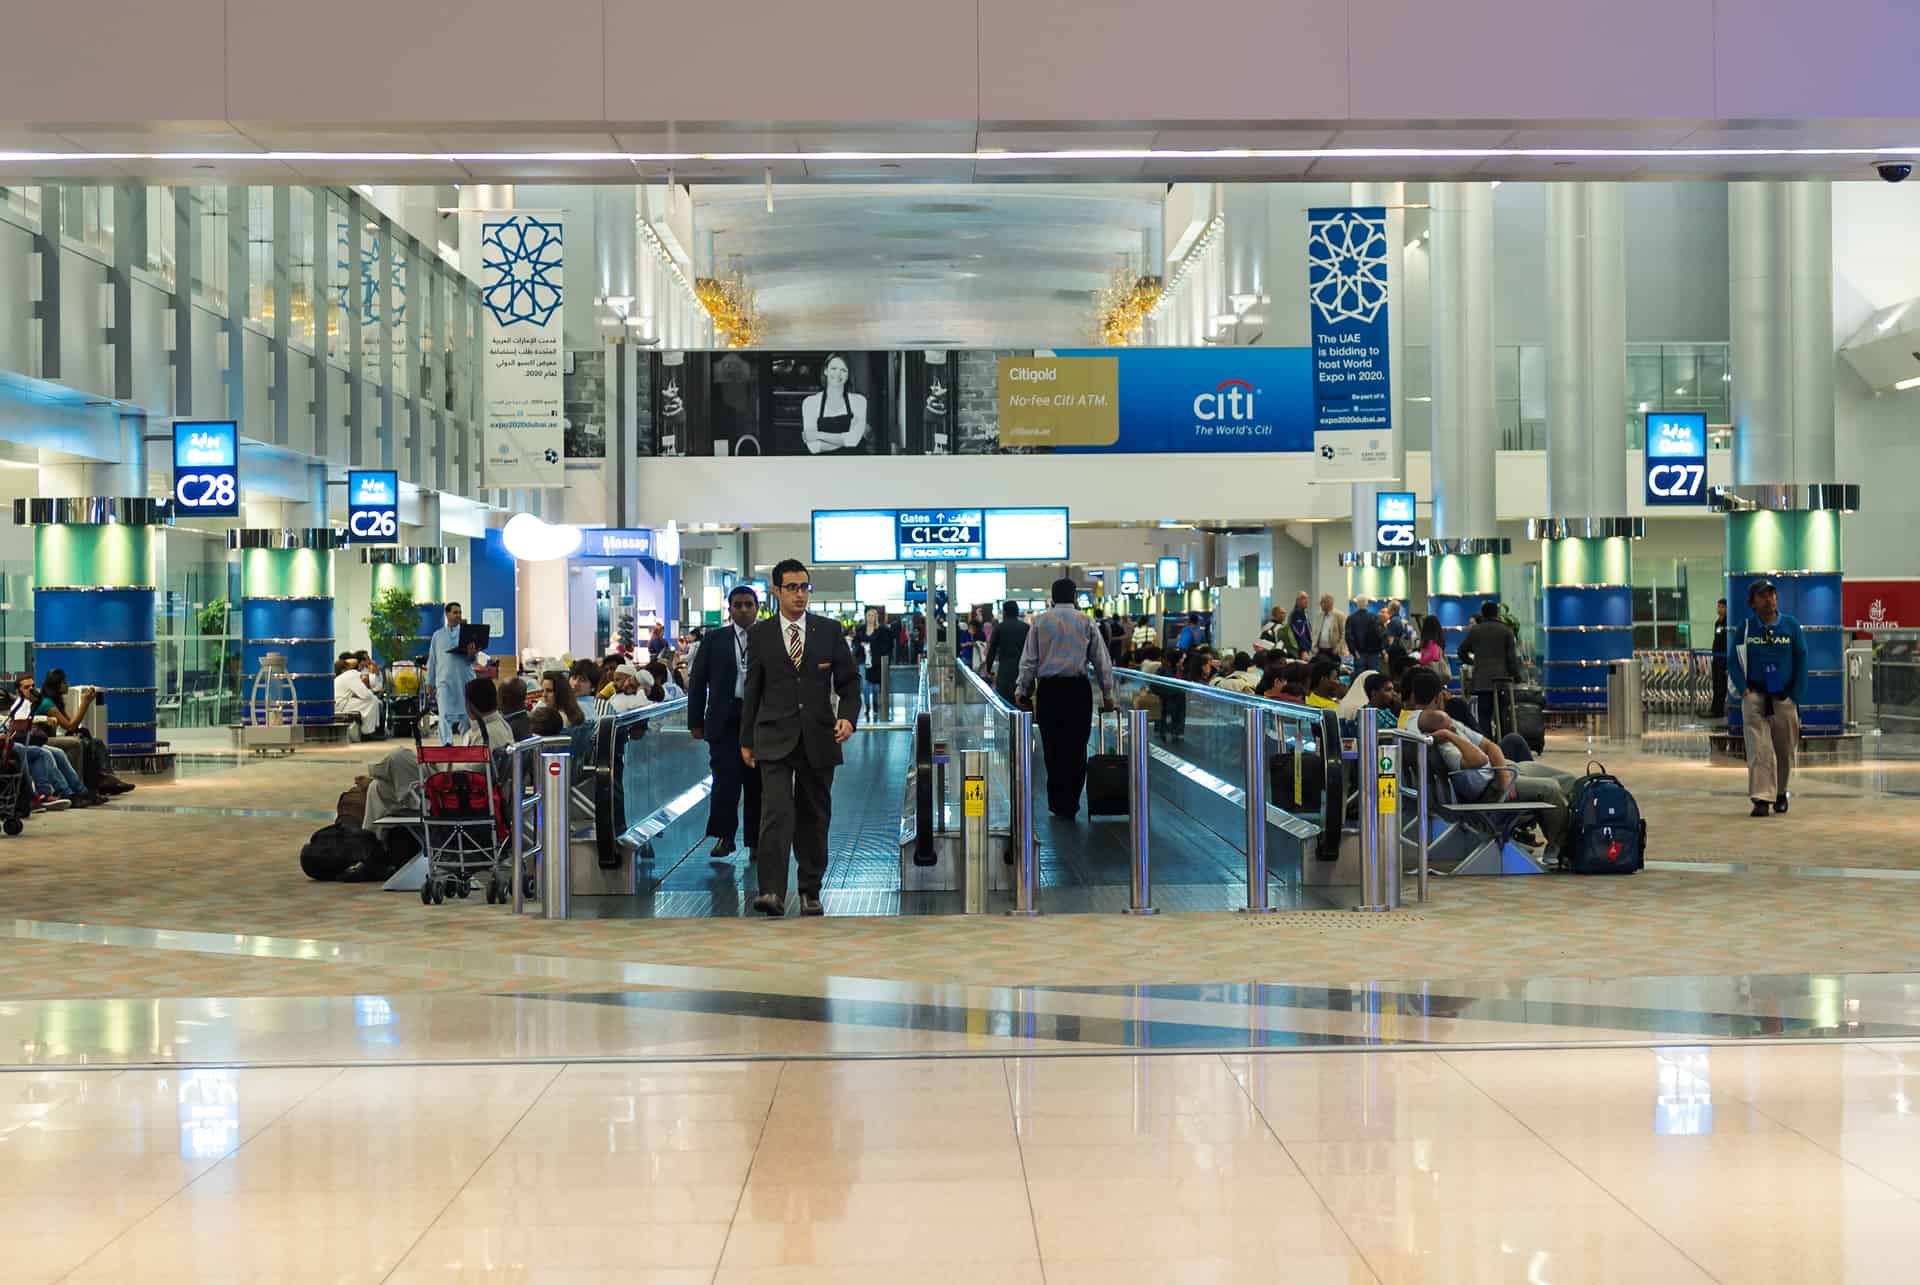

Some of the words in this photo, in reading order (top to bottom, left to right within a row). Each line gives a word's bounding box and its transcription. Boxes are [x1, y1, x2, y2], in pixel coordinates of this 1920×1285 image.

[1317, 334, 1336, 344] The
[1339, 333, 1361, 343] UAE
[1318, 346, 1327, 356] is
[1329, 346, 1367, 358] bidding
[1369, 346, 1380, 356] to
[1318, 359, 1340, 369] host
[1343, 358, 1373, 369] World
[1009, 367, 1057, 383] Citigold
[1319, 371, 1345, 383] Expo
[1347, 371, 1357, 381] in
[1358, 370, 1385, 381] 2020.
[1009, 394, 1051, 407] No-fee
[1054, 394, 1074, 406] Citi
[1077, 393, 1109, 406] ATM.
[1193, 385, 1254, 420] citi
[1195, 425, 1213, 435] The
[1216, 424, 1252, 435] World's
[1255, 424, 1273, 435] Citi
[1648, 465, 1705, 497] C27
[177, 474, 236, 506] C28
[350, 511, 396, 537] C26
[900, 513, 930, 524] Gates
[911, 527, 970, 542] C1-C24
[1377, 525, 1415, 546] C25
[1856, 620, 1899, 630] Emirates
